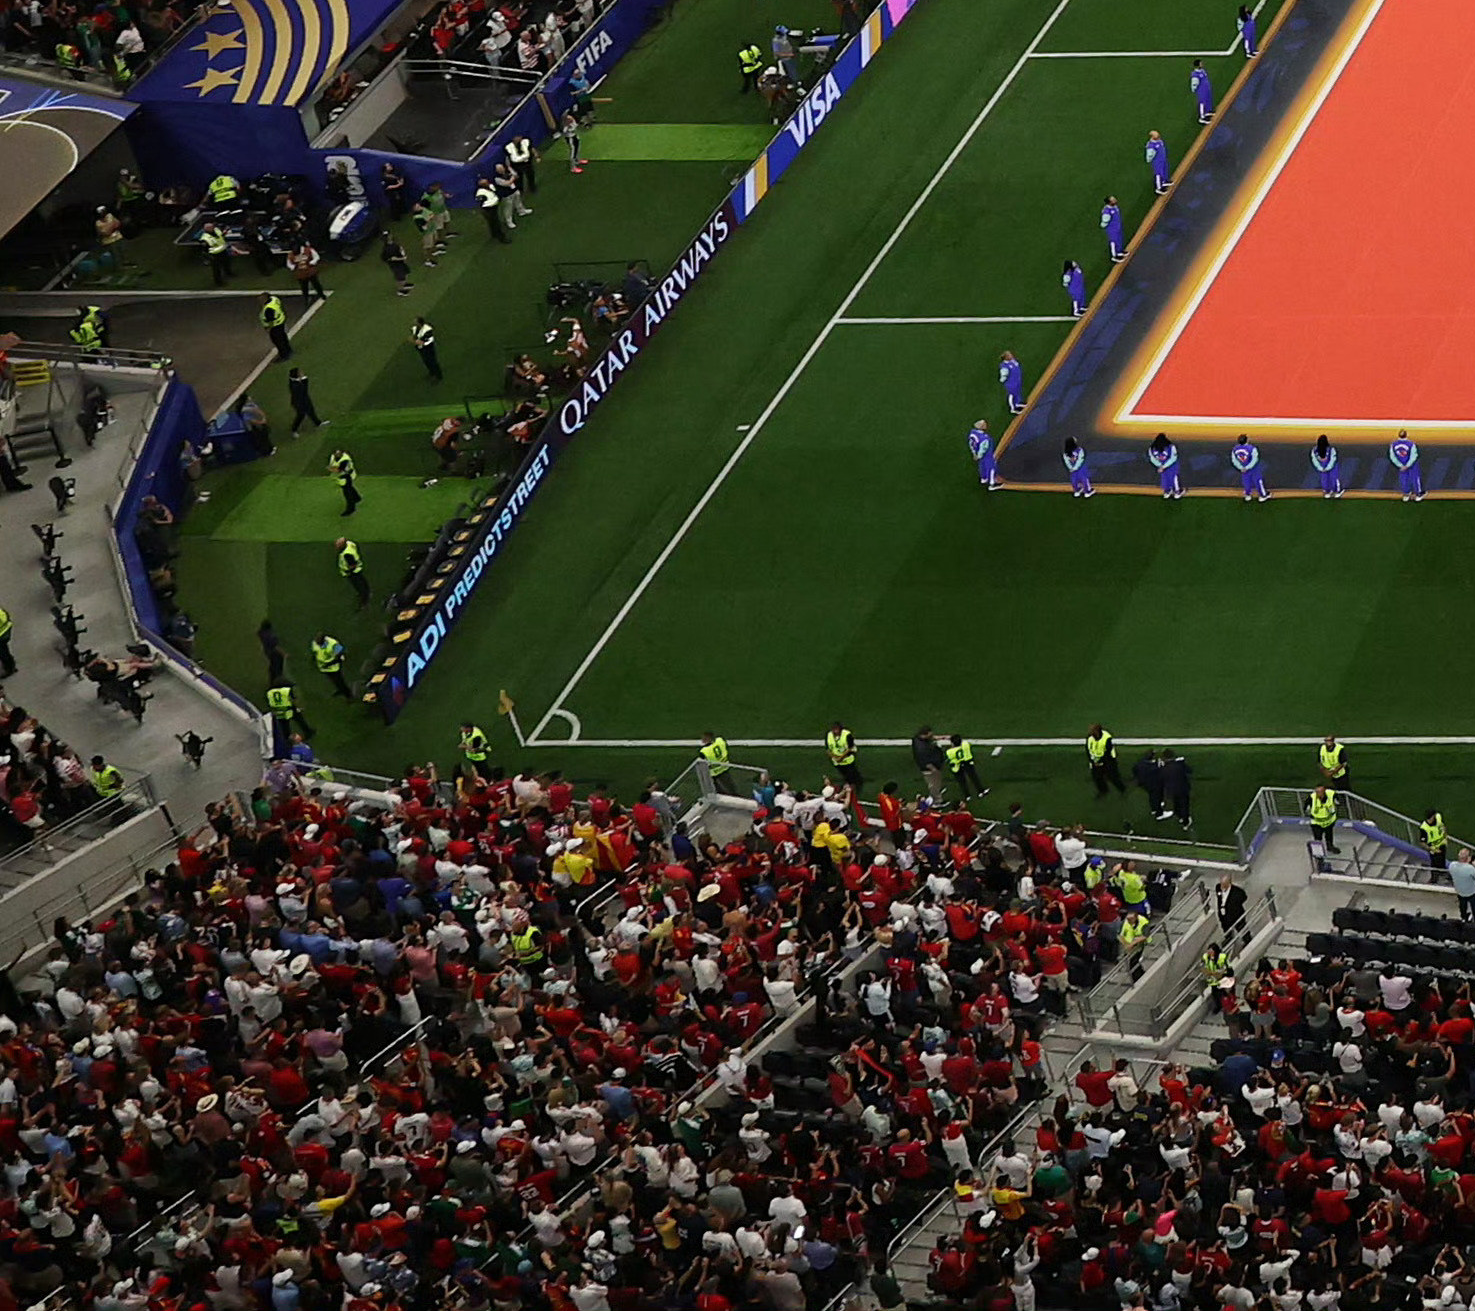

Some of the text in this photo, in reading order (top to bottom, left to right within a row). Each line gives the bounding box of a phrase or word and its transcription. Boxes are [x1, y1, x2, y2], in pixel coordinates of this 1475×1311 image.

[575, 30, 613, 75] FIFA
[784, 71, 842, 148] VISA
[559, 211, 729, 436] QATAR AIRWAYS
[406, 443, 551, 688] ADI PREDICTSTREET
